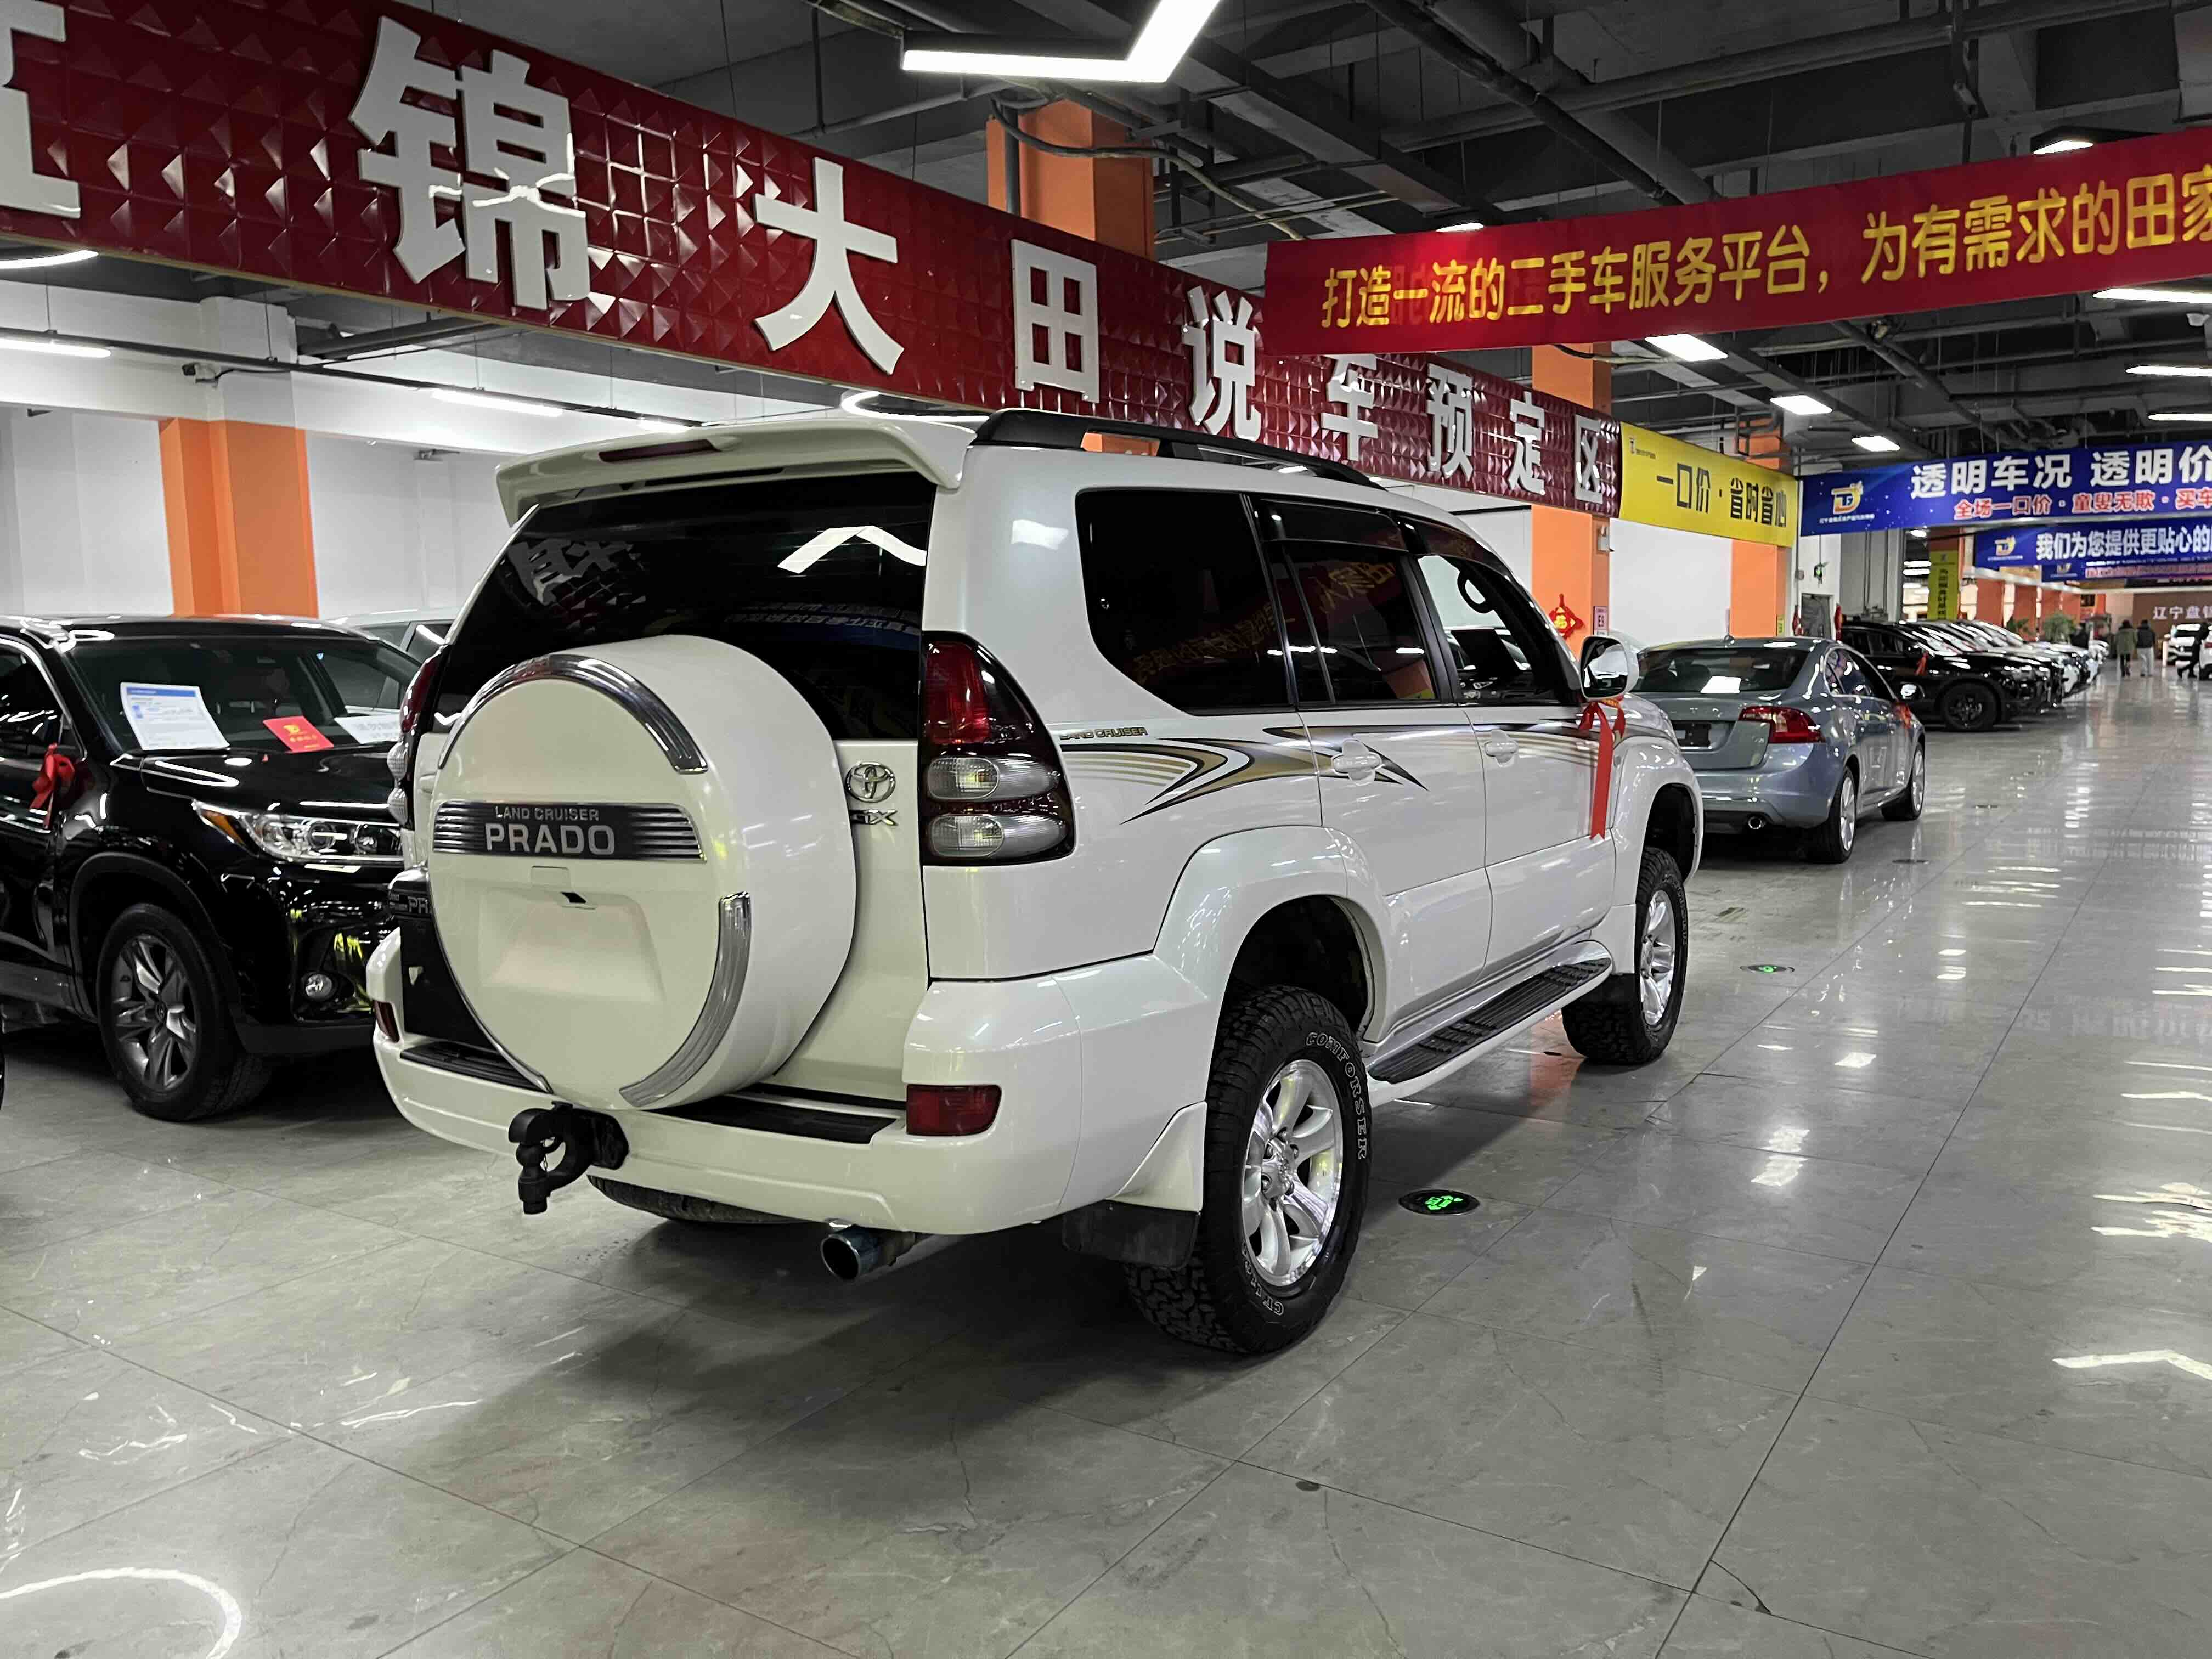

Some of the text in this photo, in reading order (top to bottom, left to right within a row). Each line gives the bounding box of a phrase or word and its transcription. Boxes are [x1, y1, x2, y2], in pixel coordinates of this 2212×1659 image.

[1911, 445, 2212, 499] 透明车况 透明价
[2036, 524, 2212, 560] 我们为您提供更贴心的
[1095, 727, 1148, 738] CRUISER
[495, 806, 599, 821] LAND CRUISER
[486, 823, 614, 855] PRADO
[1306, 1032, 1367, 1159] COMFORSER
